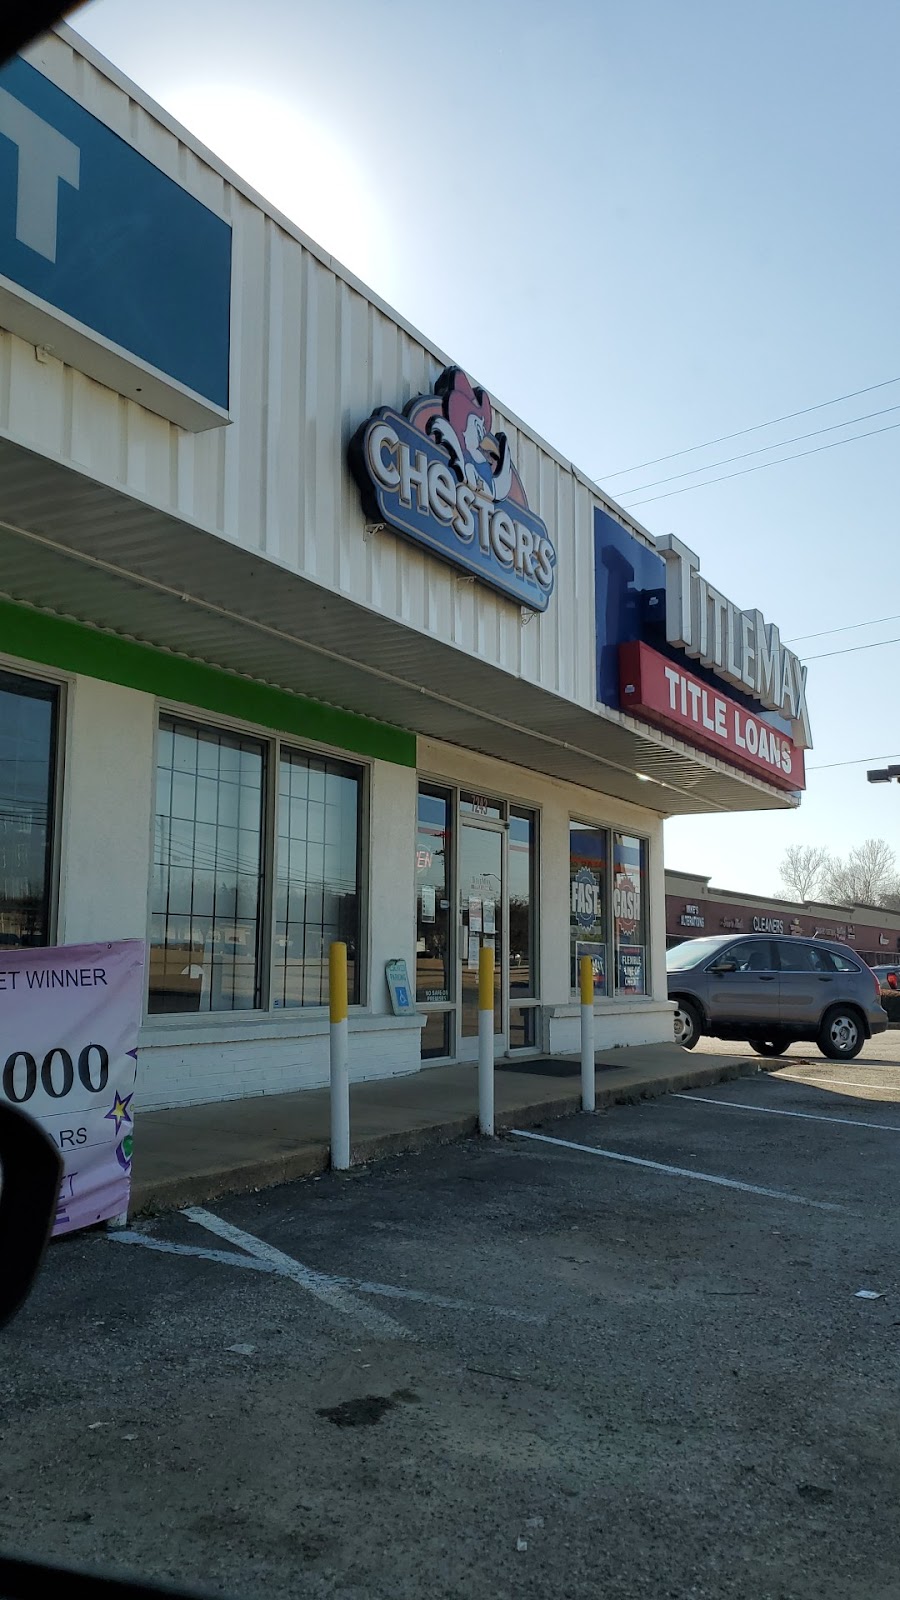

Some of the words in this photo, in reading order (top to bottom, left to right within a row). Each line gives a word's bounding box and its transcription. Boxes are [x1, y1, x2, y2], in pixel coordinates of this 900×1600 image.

[664, 666, 729, 739] TITLE
[734, 709, 792, 774] LOANS
[471, 794, 488, 816] 7243
[571, 880, 600, 915] FAST
[613, 888, 641, 921] CASH
[752, 915, 784, 934] CLEANERS
[621, 955, 642, 966] FLEXIBLE
[26, 968, 108, 989] WINNER
[624, 976, 640, 986] CREDIT
